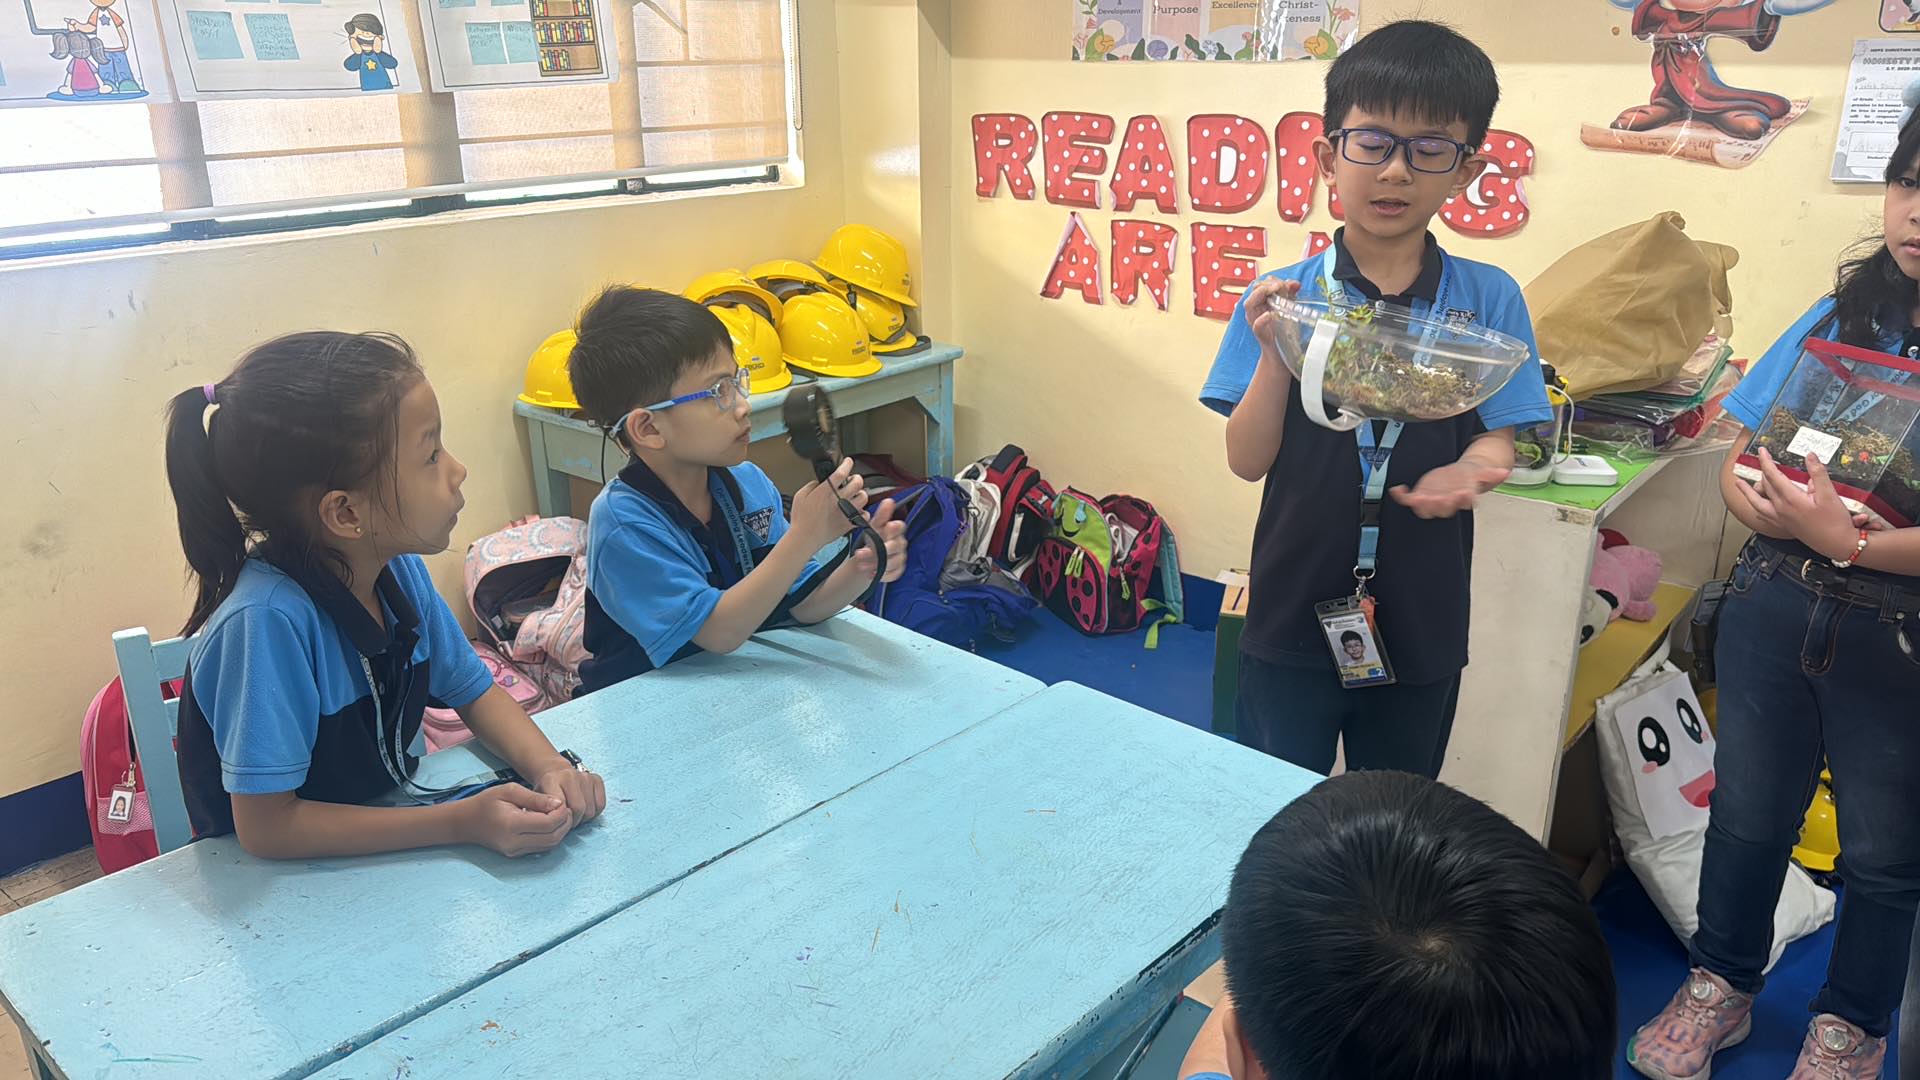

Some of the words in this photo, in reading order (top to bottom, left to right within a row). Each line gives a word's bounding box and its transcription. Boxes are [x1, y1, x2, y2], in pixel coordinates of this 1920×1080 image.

[1279, 1, 1319, 9] Christ-
[1098, 8, 1142, 16] Development
[1153, 5, 1199, 16] Purpose
[1275, 13, 1321, 23] eness
[1863, 57, 1912, 65] HONESTY
[971, 111, 1536, 239] READIG
[1040, 211, 1333, 321] ARE
